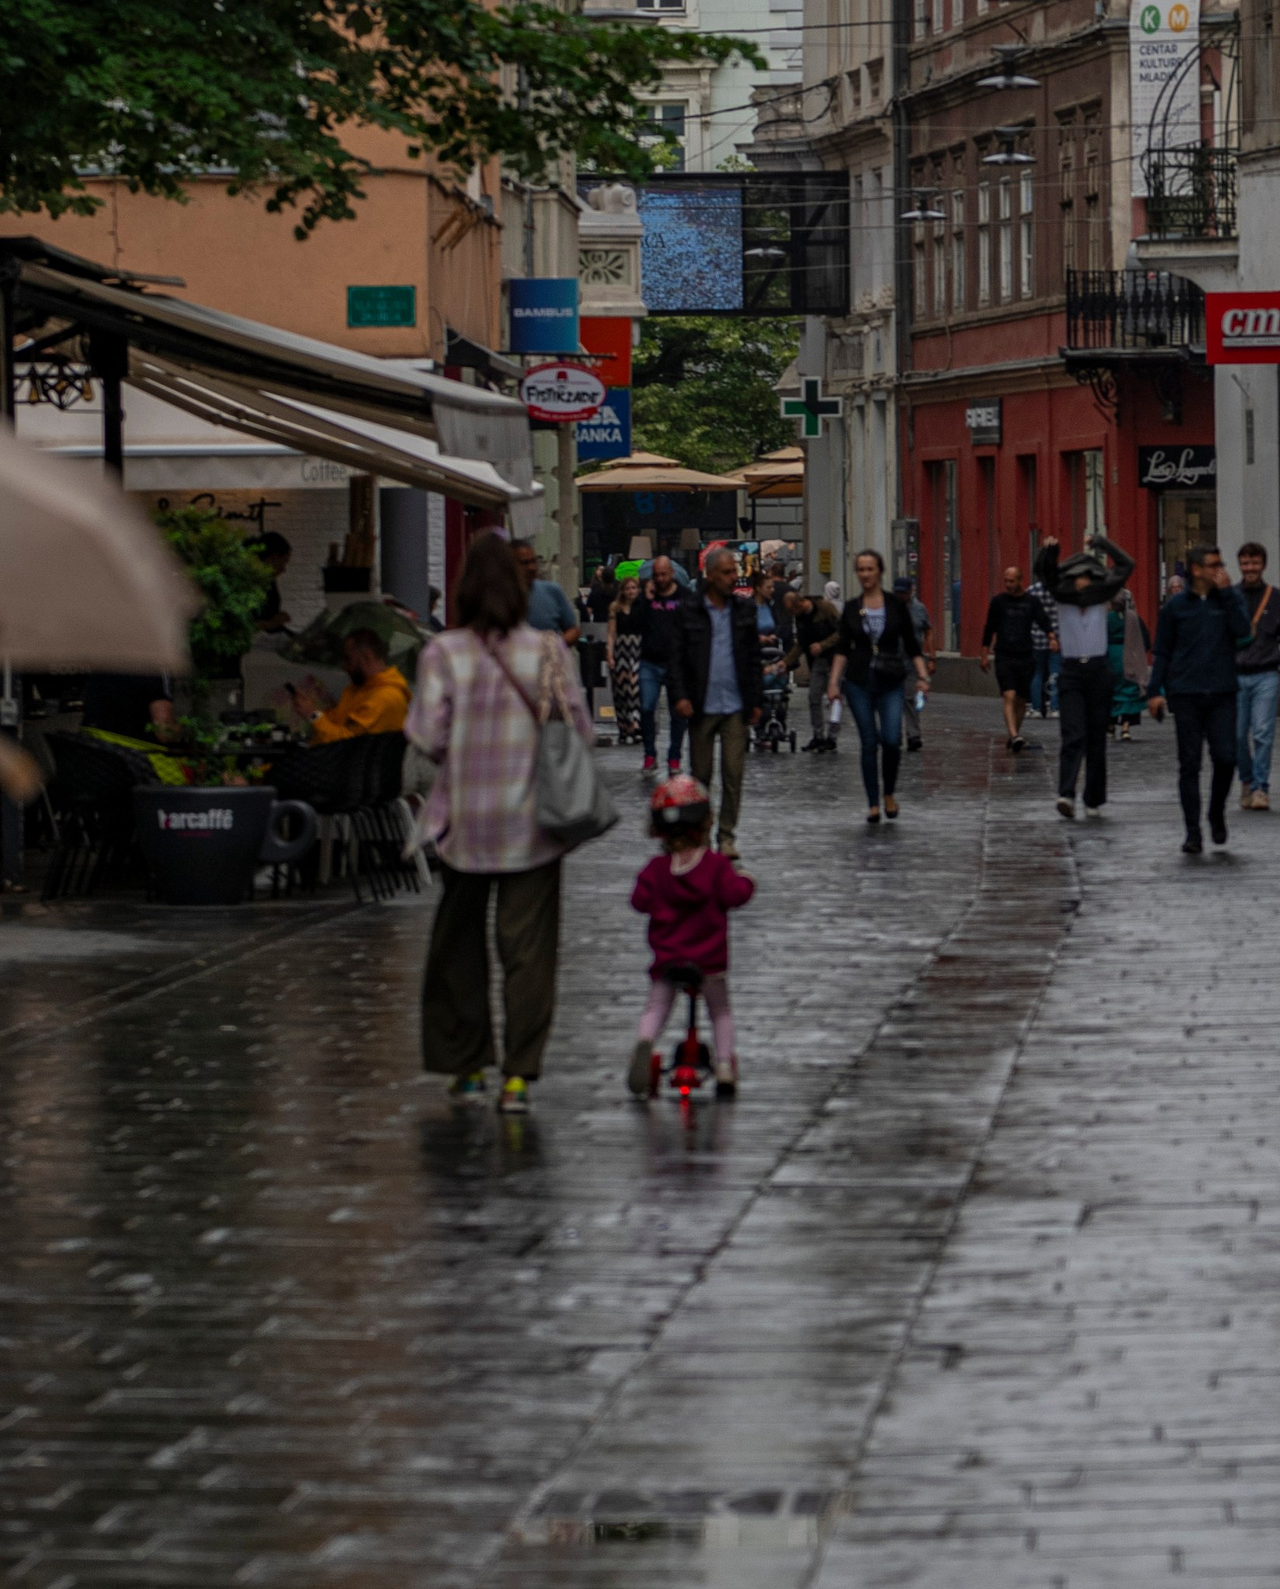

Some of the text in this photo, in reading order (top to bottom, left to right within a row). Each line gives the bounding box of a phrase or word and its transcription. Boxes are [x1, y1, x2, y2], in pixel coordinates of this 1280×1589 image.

[1139, 44, 1178, 55] CENTAR
[513, 307, 573, 318] BAMBUS
[300, 458, 348, 483] Coffee
